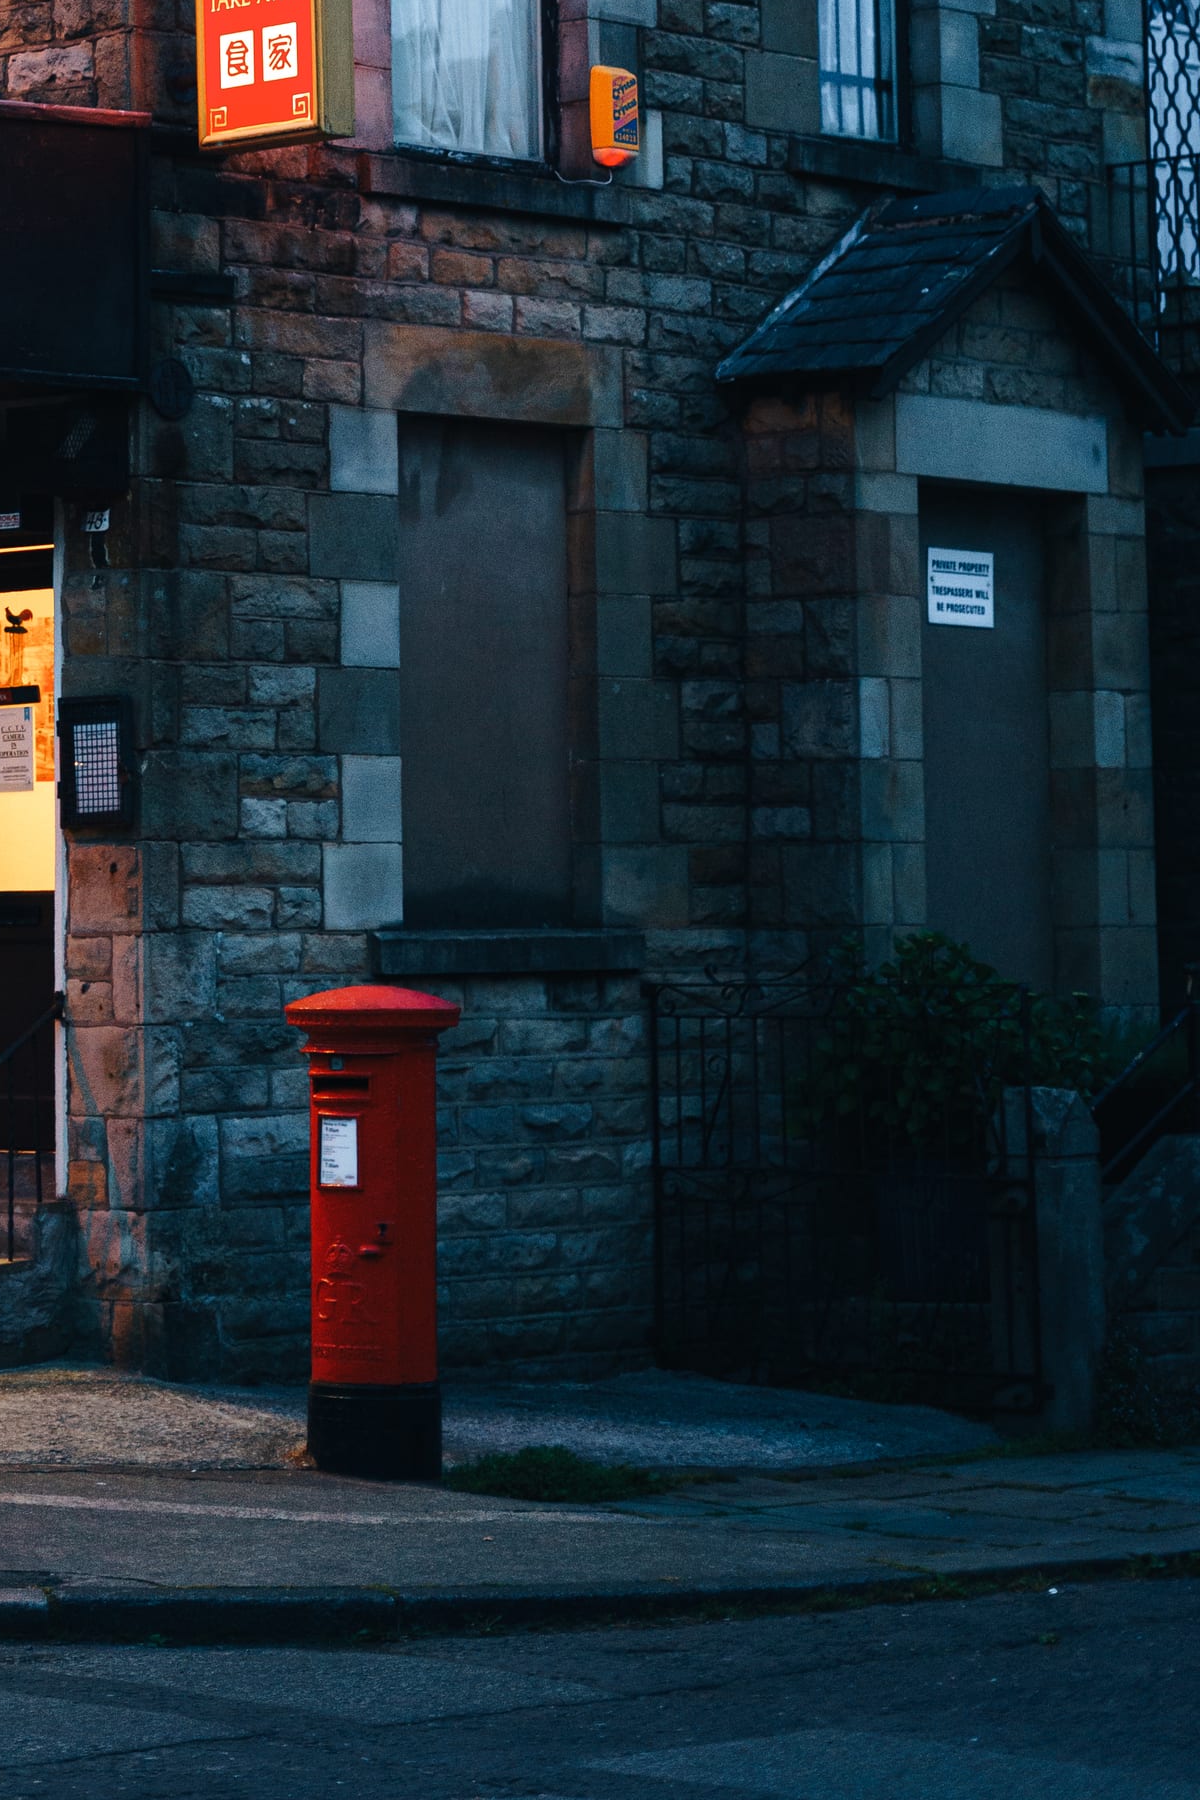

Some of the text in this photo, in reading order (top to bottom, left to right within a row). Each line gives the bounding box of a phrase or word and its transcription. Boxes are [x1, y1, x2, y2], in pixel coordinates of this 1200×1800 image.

[931, 559, 990, 573] PRIVATE PROPERTY
[932, 585, 990, 600] TRESPASSERS WILL
[936, 601, 986, 615] BE PROSECUTED
[0, 749, 29, 758] OPERATION
